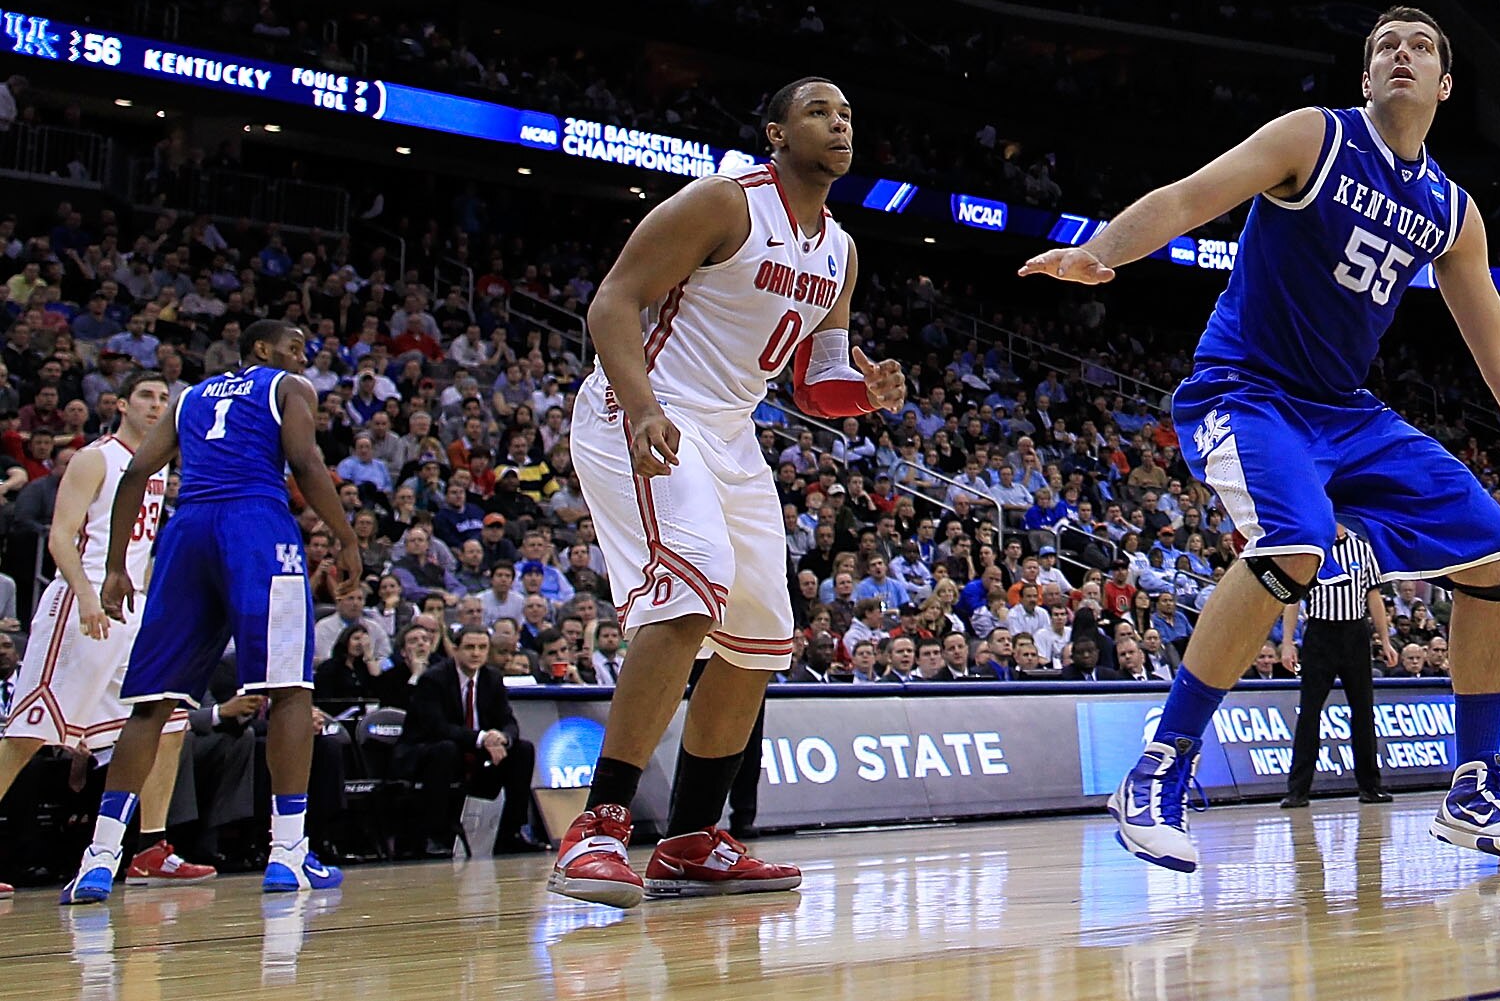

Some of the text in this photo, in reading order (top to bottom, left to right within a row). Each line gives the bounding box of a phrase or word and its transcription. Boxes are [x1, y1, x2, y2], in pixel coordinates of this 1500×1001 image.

[83, 33, 122, 66] 56
[143, 49, 272, 91] KENTUCKY
[291, 67, 348, 94] FOULS
[312, 88, 347, 111] TOL
[520, 125, 557, 146] NCAA
[562, 135, 716, 179] CHAMPIONSHIP
[564, 117, 714, 162] 2011 BASKETBALL
[958, 202, 1002, 227] NCAA
[1333, 174, 1445, 254] KENTUCKY
[753, 259, 796, 299] OHIO
[1333, 225, 1415, 306] 55
[758, 309, 803, 373] 0
[204, 398, 227, 440] 1
[1212, 706, 1291, 745] NCAA
[852, 731, 1009, 782] STATE
[1386, 741, 1449, 769] JERSEY
